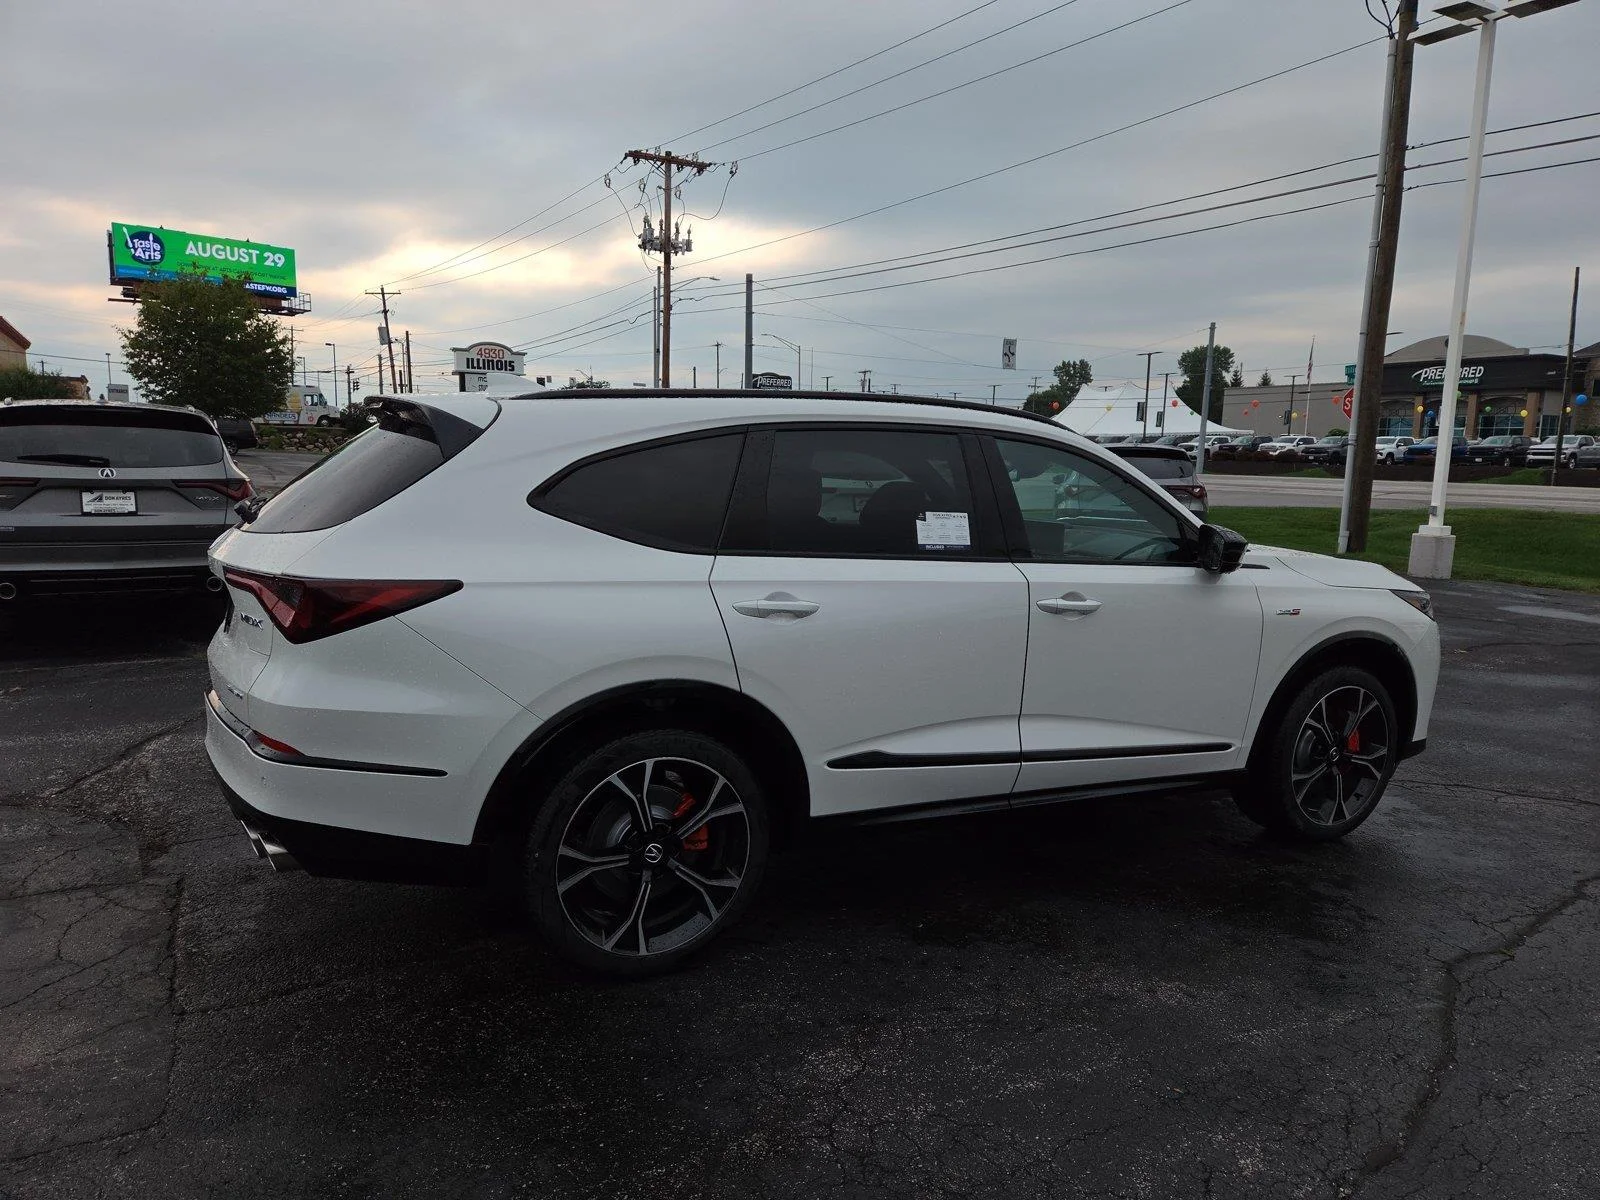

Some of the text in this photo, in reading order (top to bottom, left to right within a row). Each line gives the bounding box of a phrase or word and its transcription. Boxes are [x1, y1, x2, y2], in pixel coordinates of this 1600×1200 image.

[133, 238, 160, 251] Taste
[135, 247, 161, 260] Arts
[185, 241, 285, 268] AUGUST 29
[244, 282, 287, 294] ASTEFW.ORG
[476, 348, 505, 359] 4930
[466, 357, 515, 372] ILLINOIS
[1420, 366, 1484, 382] PRERED
[756, 376, 792, 387] PREFERRED
